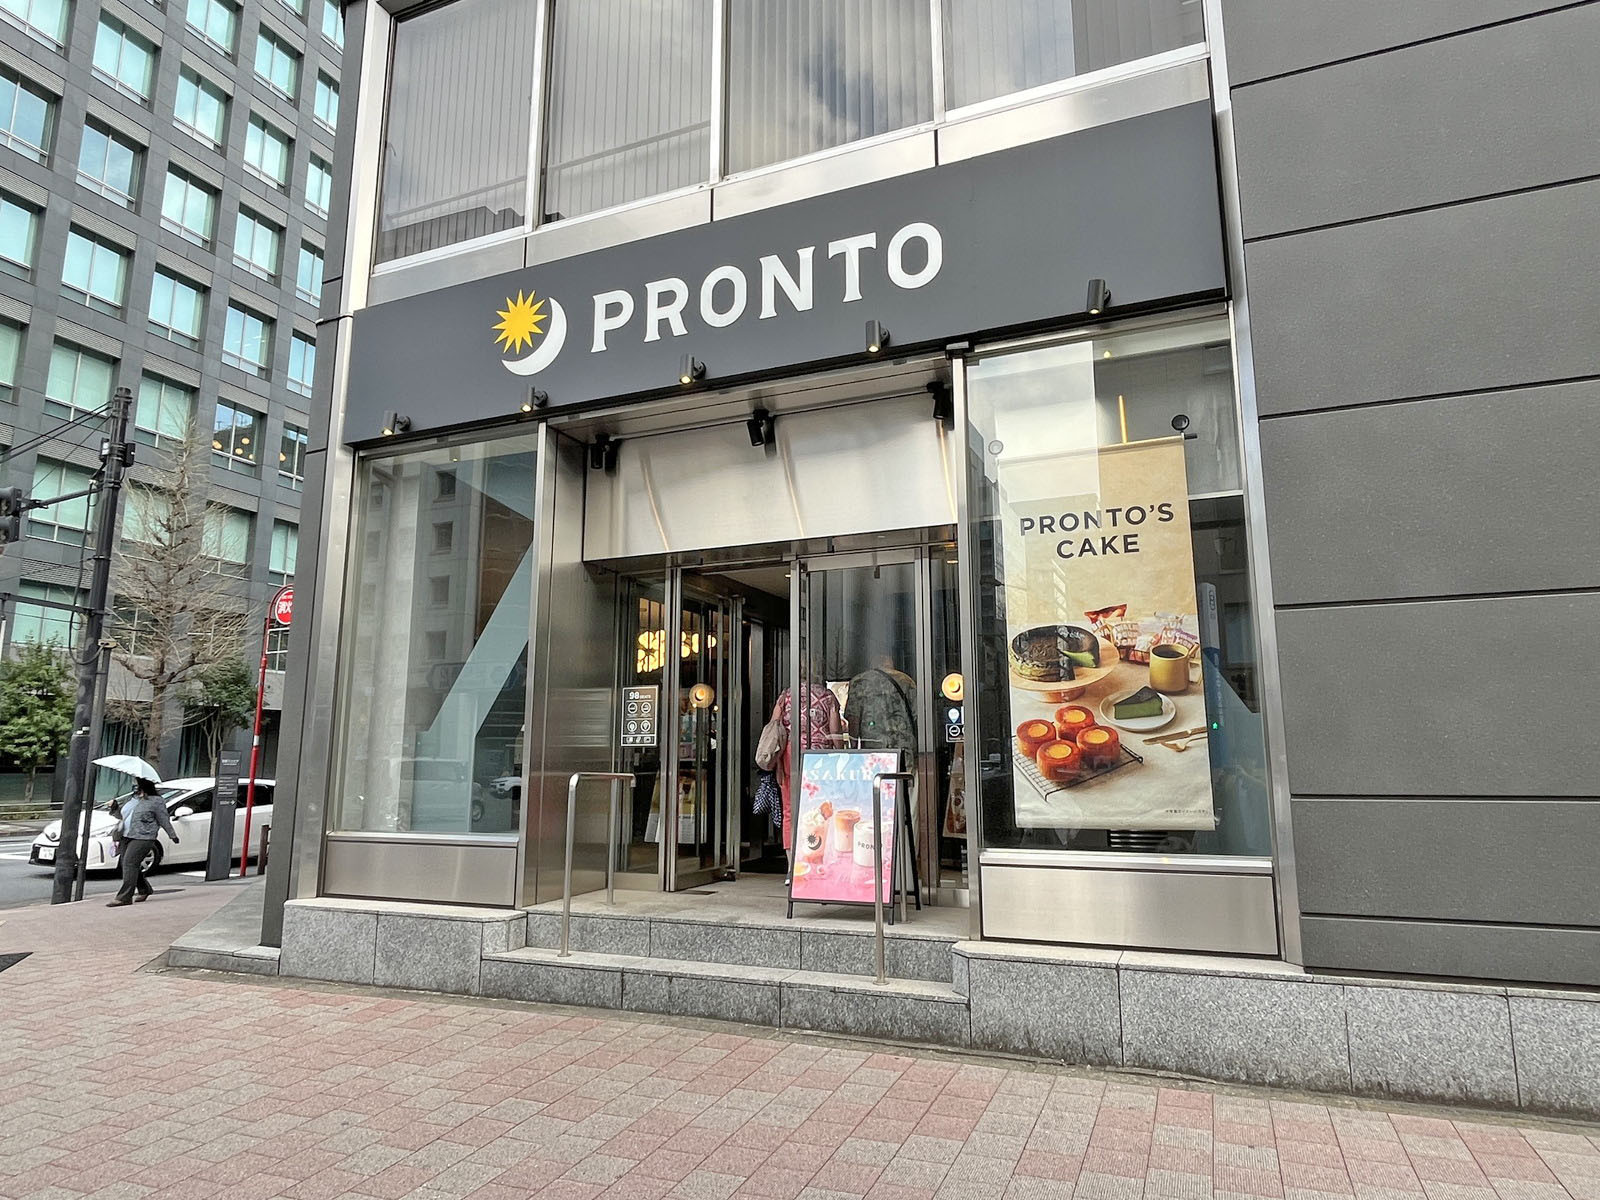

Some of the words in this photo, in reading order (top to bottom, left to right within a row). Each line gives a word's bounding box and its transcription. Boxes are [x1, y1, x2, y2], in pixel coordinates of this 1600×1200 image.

[590, 221, 943, 354] PRONTO
[1020, 502, 1174, 537] PRONTO’S
[1056, 533, 1140, 559] CAKE
[629, 691, 640, 700] 98
[807, 768, 876, 781] SAKUR
